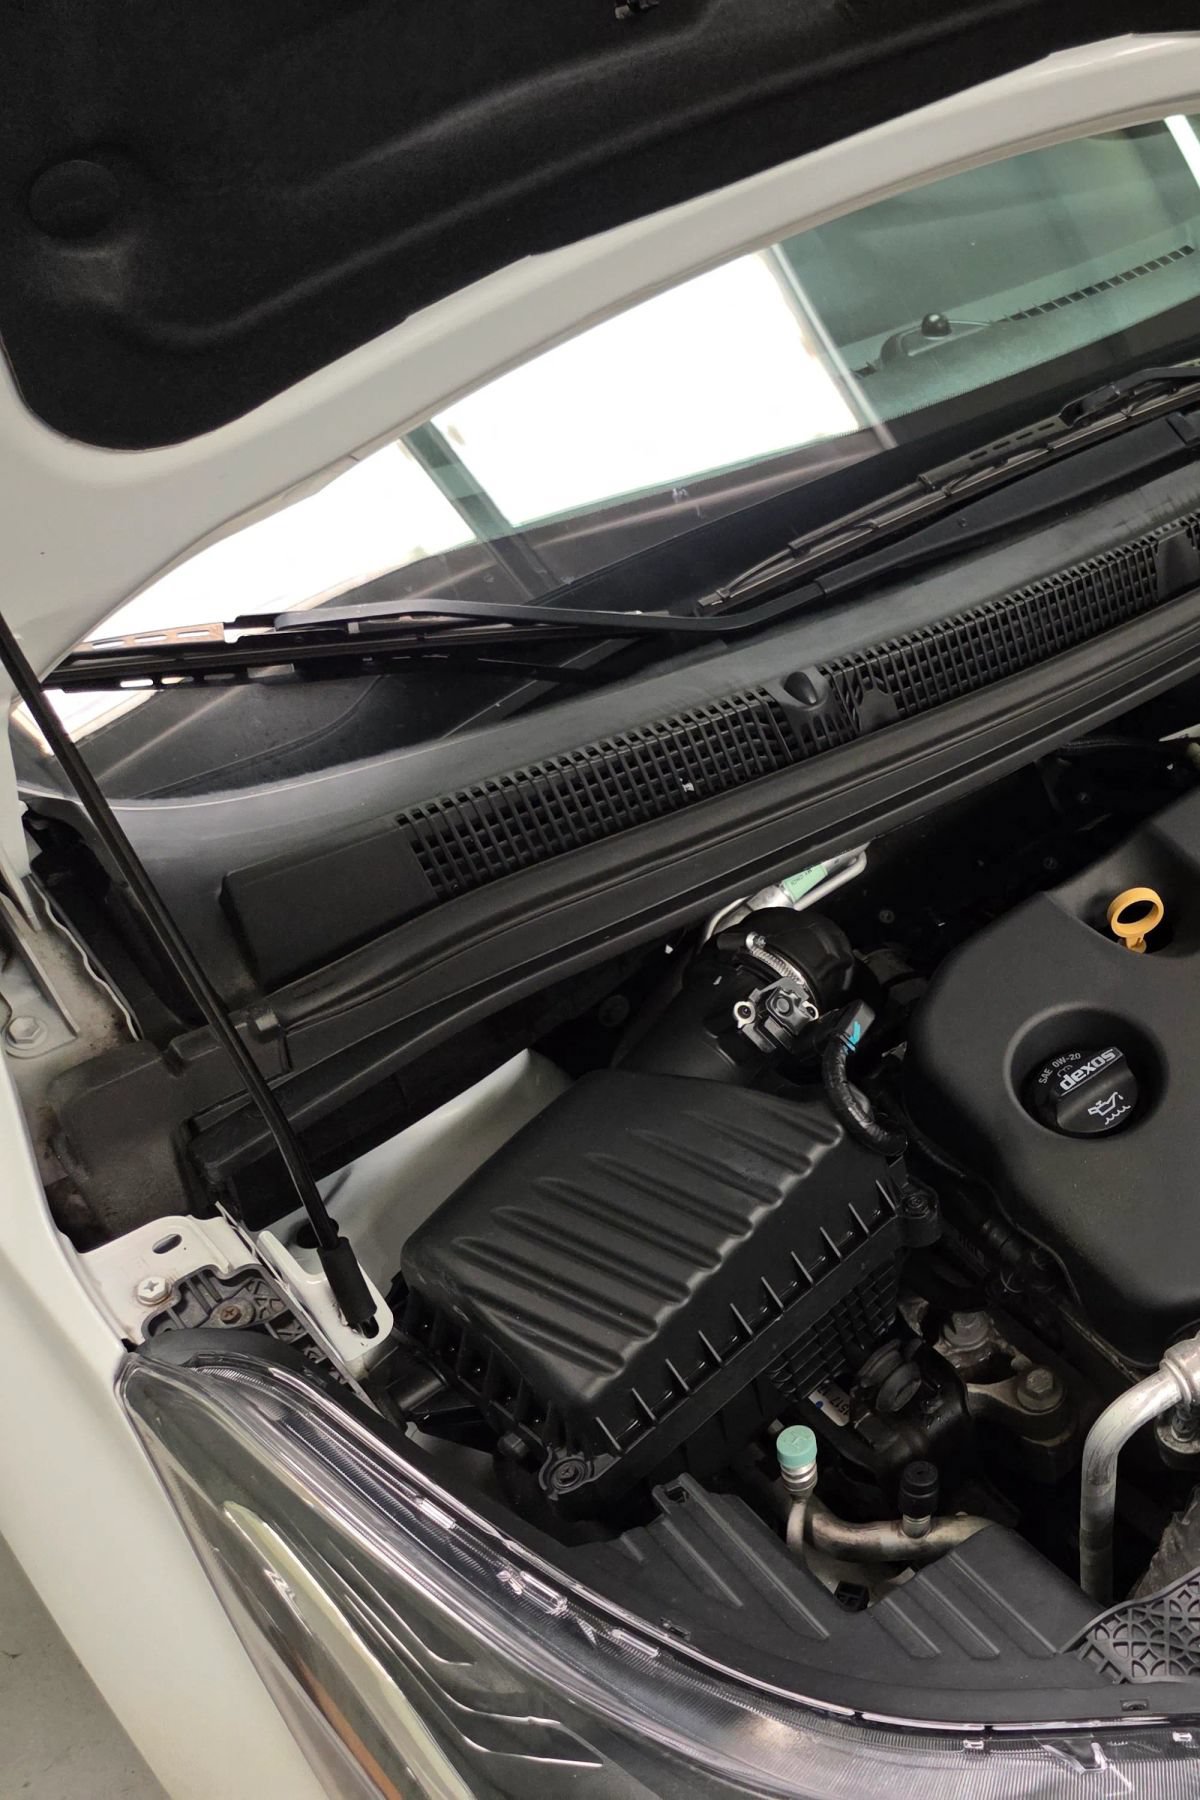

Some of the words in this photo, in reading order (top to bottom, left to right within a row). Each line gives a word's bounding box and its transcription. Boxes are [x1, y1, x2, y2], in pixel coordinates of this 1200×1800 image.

[1038, 1068, 1053, 1084] SAE
[1052, 1052, 1081, 1068] 0W-20
[1060, 1048, 1116, 1091] dexos
